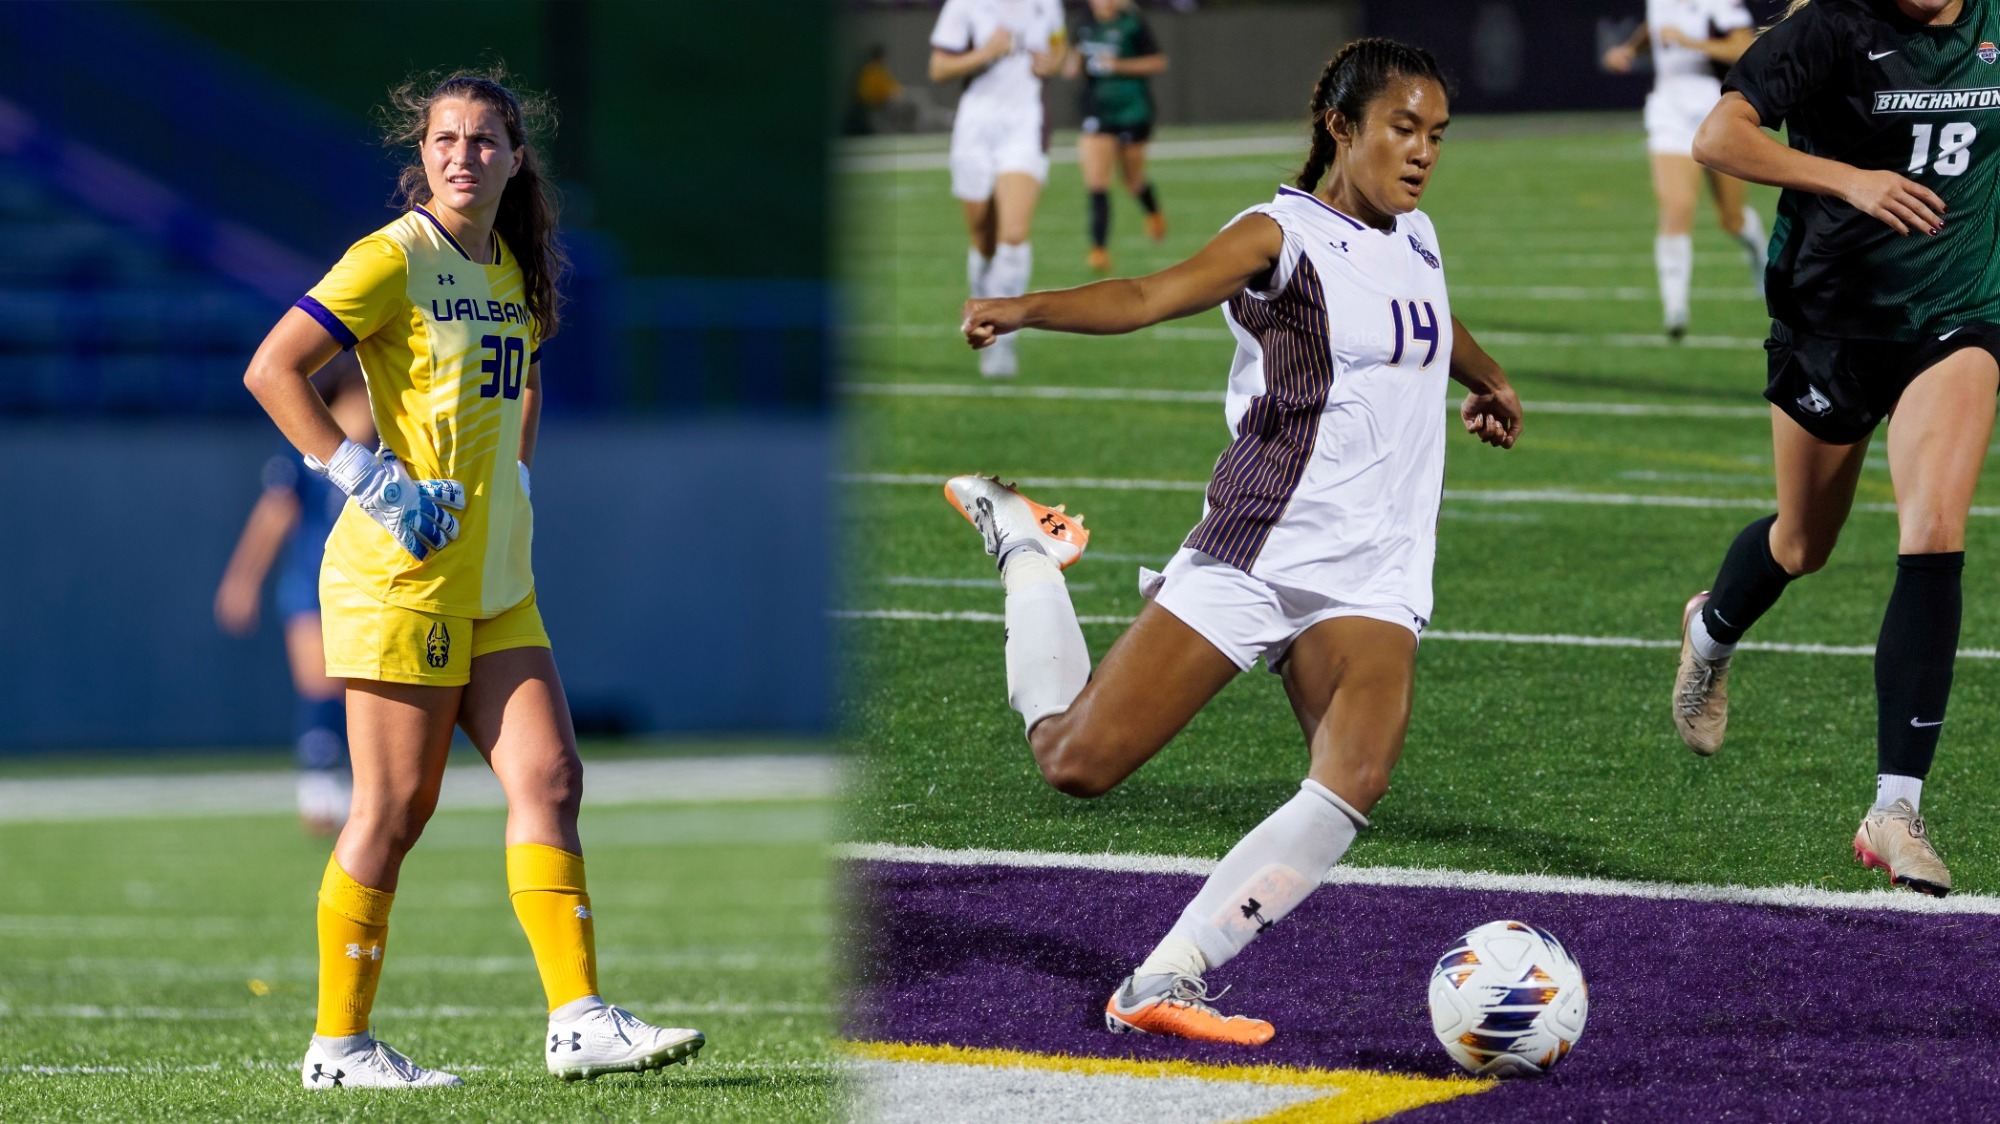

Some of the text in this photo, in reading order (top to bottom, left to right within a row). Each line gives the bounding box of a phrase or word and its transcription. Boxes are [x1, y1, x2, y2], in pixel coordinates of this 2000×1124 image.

[1876, 90, 2000, 111] BINGHAMTON
[1908, 121, 1977, 177] 18
[432, 299, 530, 326] UALBAN
[1388, 298, 1441, 370] 14
[480, 335, 523, 400] 30
